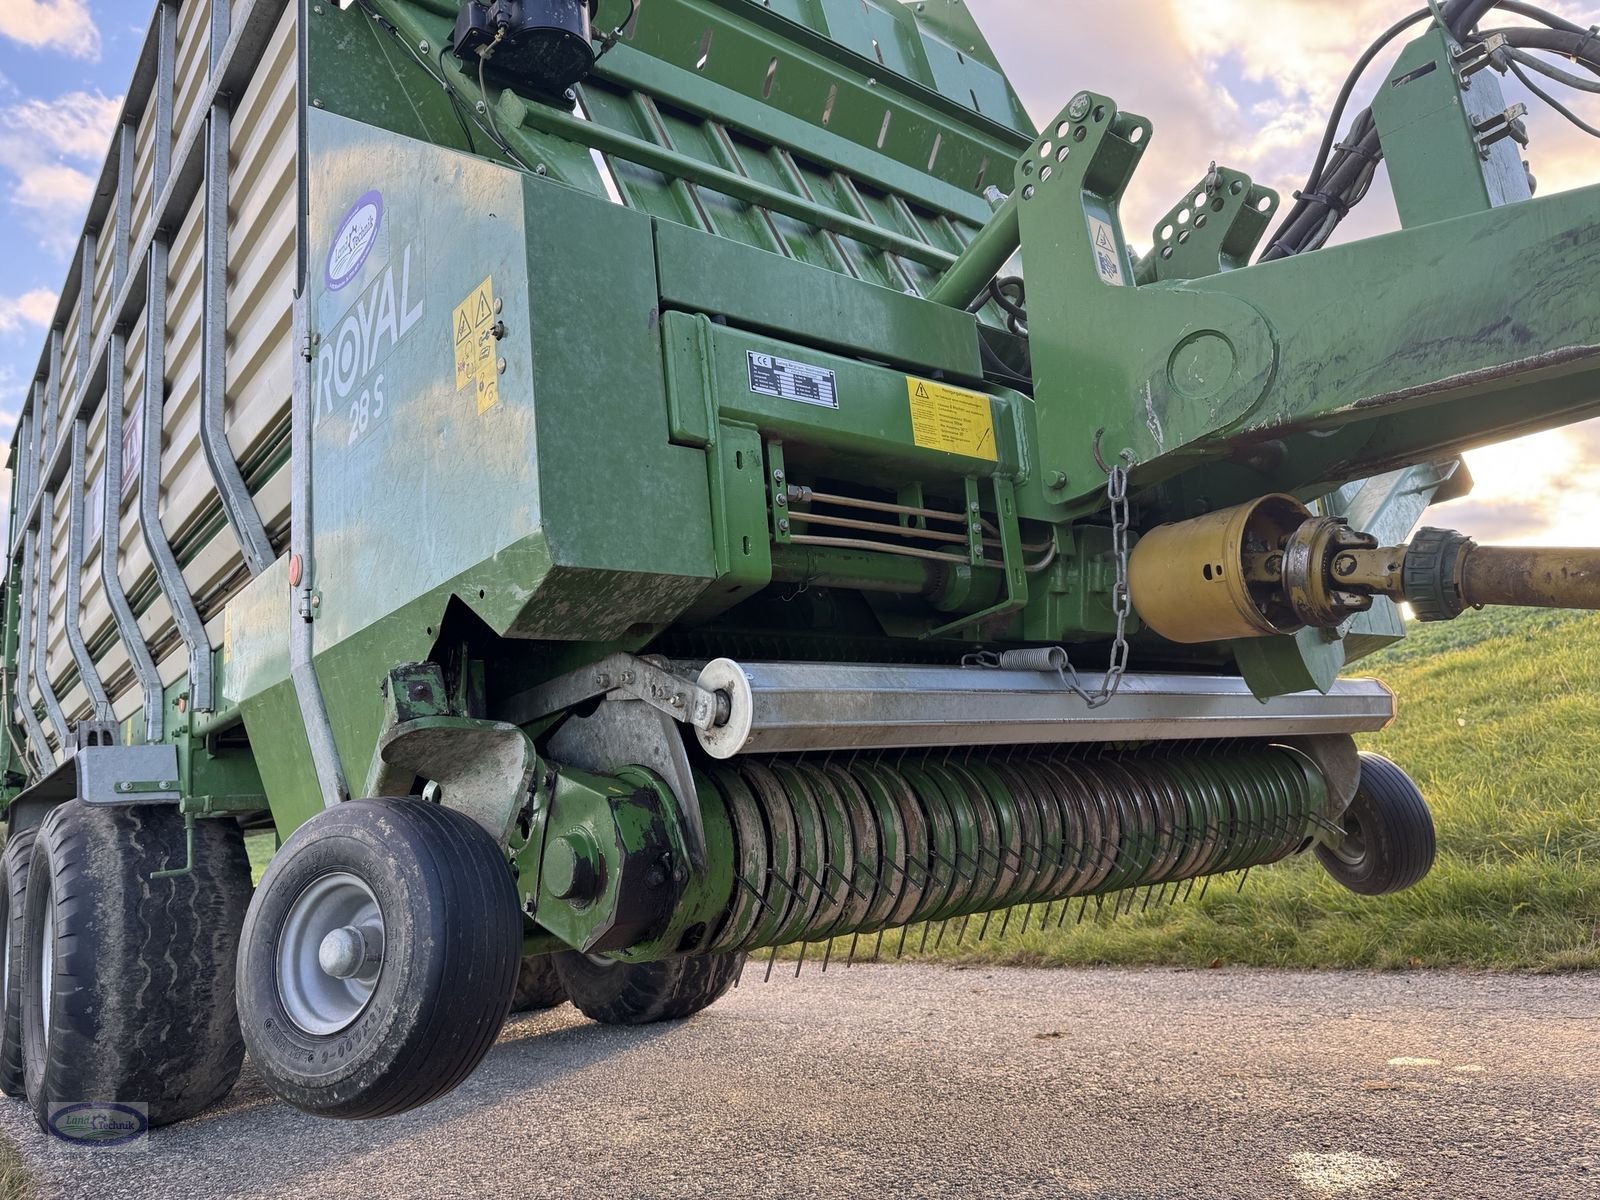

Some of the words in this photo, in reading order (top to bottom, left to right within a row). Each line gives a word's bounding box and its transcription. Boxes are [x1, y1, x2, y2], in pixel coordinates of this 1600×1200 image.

[313, 243, 424, 429] ROYAL
[348, 389, 370, 446] 28
[373, 373, 385, 420] S
